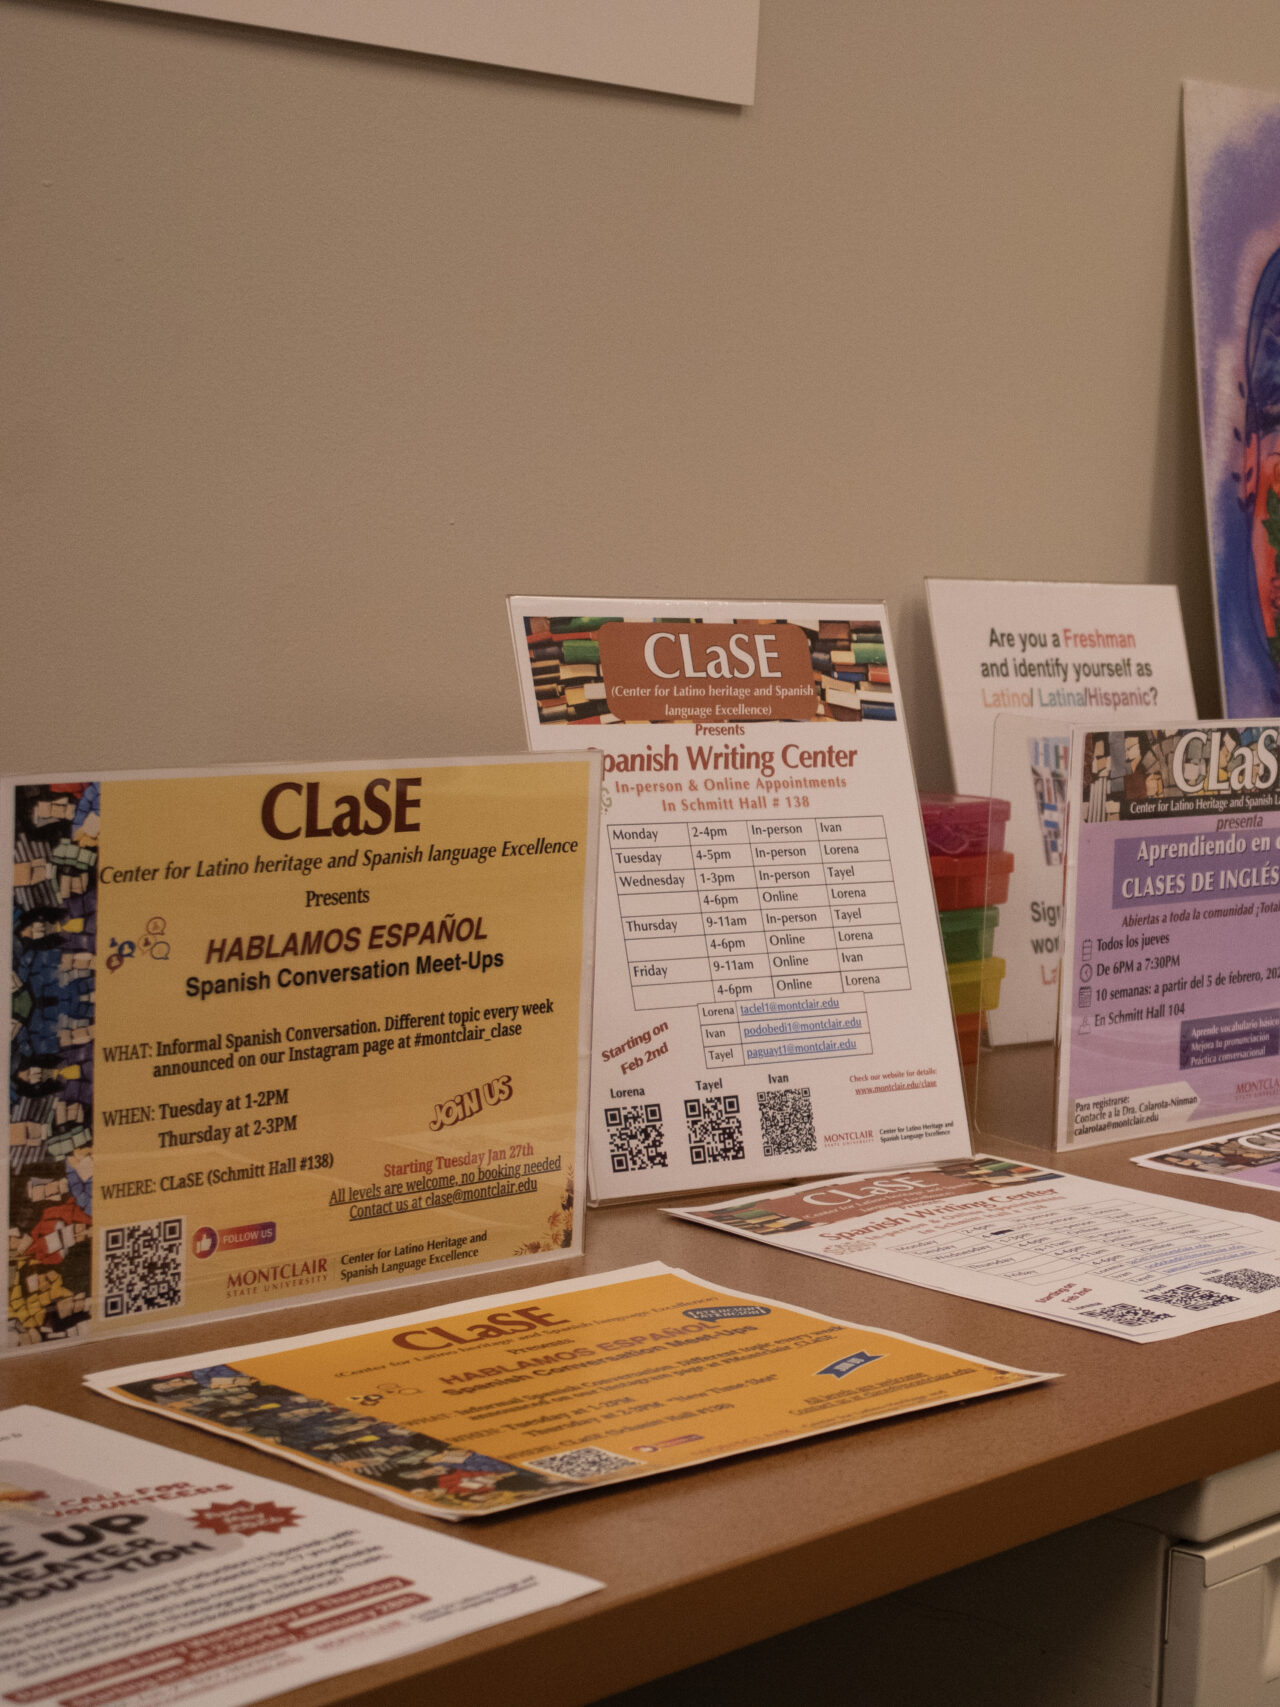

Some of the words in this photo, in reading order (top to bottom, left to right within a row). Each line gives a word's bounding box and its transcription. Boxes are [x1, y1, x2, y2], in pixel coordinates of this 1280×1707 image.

[988, 627, 1016, 648] Are
[1017, 632, 1048, 653] you
[1051, 632, 1061, 648] a
[1062, 628, 1136, 649] Freshman
[643, 632, 782, 679] CLaSE
[980, 657, 1010, 678] and
[1012, 657, 1068, 682] identify
[1072, 657, 1132, 682] yourself
[1135, 661, 1153, 678] as
[610, 685, 652, 697] (Center
[654, 684, 670, 697] for
[673, 684, 706, 696] Latino
[708, 684, 751, 700] heritage
[753, 684, 773, 696] and
[775, 684, 814, 699] Spanish
[981, 687, 1034, 708] Latino/
[1037, 686, 1158, 711] Latina/Hispanic?
[664, 703, 712, 719] language
[714, 703, 772, 716] Excellence)
[694, 723, 745, 736] Presents
[587, 744, 680, 782] panish
[685, 743, 775, 776] Writing
[781, 743, 858, 769] Center
[614, 781, 683, 797] In-person
[687, 778, 698, 792] &
[703, 777, 750, 791] Online
[755, 775, 847, 793] Appointments
[260, 776, 422, 841] CLaSE
[661, 799, 676, 812] In
[680, 796, 734, 811] Schmitt
[738, 795, 767, 809] Hall
[772, 797, 780, 808] #
[785, 795, 810, 808] 138
[612, 827, 658, 842] Monday
[691, 826, 728, 840] 2-4pm
[751, 824, 803, 838] In-person
[819, 822, 842, 833] Ivan
[1214, 813, 1263, 832] presenta
[97, 865, 160, 884] Center
[164, 860, 191, 880] for
[195, 857, 249, 877] Latino
[253, 853, 323, 876] heritage
[326, 848, 359, 869] and
[361, 844, 423, 871] Spanish
[427, 843, 497, 866] language
[501, 837, 578, 857] Excellence
[615, 850, 662, 866] Tuesday
[695, 849, 731, 863] 4-5pm
[754, 847, 807, 861] In-person
[823, 844, 859, 855] Lorena
[1136, 832, 1246, 866] Aprendiendo
[1251, 836, 1271, 851] en
[618, 873, 685, 887] Wednesday
[699, 872, 735, 886] 1-3pm
[758, 869, 810, 884] In-person
[826, 865, 855, 879] Tayel
[1121, 873, 1185, 898] CLASES
[1190, 871, 1214, 892] DE
[1219, 863, 1279, 889] INGLÉS
[304, 887, 370, 908] Presents
[205, 926, 362, 964] HABLAMOS
[367, 913, 488, 950] ESPAÑOL
[1096, 935, 1123, 951] Todos
[1125, 934, 1139, 948] los
[1141, 932, 1170, 950] jueves
[185, 970, 270, 1000] Spanish
[277, 959, 410, 988] Conversation
[416, 950, 504, 975] Meet-Ups
[1096, 963, 1110, 976] De
[1112, 959, 1134, 974] 6PM
[1136, 961, 1142, 972] a
[1144, 954, 1180, 970] 7:30PM
[1095, 987, 1108, 1002] 10
[1109, 985, 1152, 1000] semanas:
[1153, 984, 1160, 994] a
[1161, 976, 1188, 996] partir
[1189, 974, 1204, 989] del
[1206, 974, 1212, 987] 5
[1214, 972, 1226, 986] de
[1228, 970, 1263, 984] febrero,
[702, 1007, 735, 1017] Lorena
[1094, 1013, 1106, 1027] En
[1108, 1007, 1143, 1025] Schmitt
[1145, 1004, 1165, 1019] Hall
[1168, 1002, 1185, 1016] 104
[102, 1042, 152, 1063] WHAT:
[155, 1033, 222, 1057] Informal
[225, 1027, 282, 1052] Spanish
[285, 1018, 381, 1042] Conversation.
[383, 1011, 445, 1032] Different
[448, 1006, 481, 1028] topic
[482, 1005, 520, 1024] every
[521, 998, 554, 1016] week
[601, 1030, 652, 1063] Starting
[652, 1022, 669, 1036] on
[621, 1057, 644, 1076] Feb
[644, 1041, 669, 1063] 2nd
[694, 1077, 723, 1093] Tayel
[767, 1073, 789, 1084] Ivan
[609, 1087, 646, 1099] Lorena
[102, 1105, 155, 1127] WHEN:
[158, 1097, 223, 1120] Tuesday
[225, 1095, 242, 1111] at
[244, 1088, 289, 1109] 1-2PM
[157, 1124, 232, 1148] Thursday
[234, 1122, 250, 1138] at
[253, 1114, 298, 1136] 2-3PM
[383, 1158, 434, 1178] Starting
[435, 1151, 486, 1170] Tuesday
[486, 1148, 507, 1166] Jan
[509, 1142, 534, 1159] 27th
[802, 1176, 939, 1207] CLaSE
[818, 1217, 904, 1242] Spanish
[905, 1197, 997, 1225] Writing
[989, 1187, 1059, 1205] Center
[220, 1230, 259, 1248] FOLLOW
[260, 1228, 273, 1238] US
[60, 1491, 129, 1508] CALL
[135, 1481, 196, 1496] FOR
[41, 1513, 149, 1548] UP
